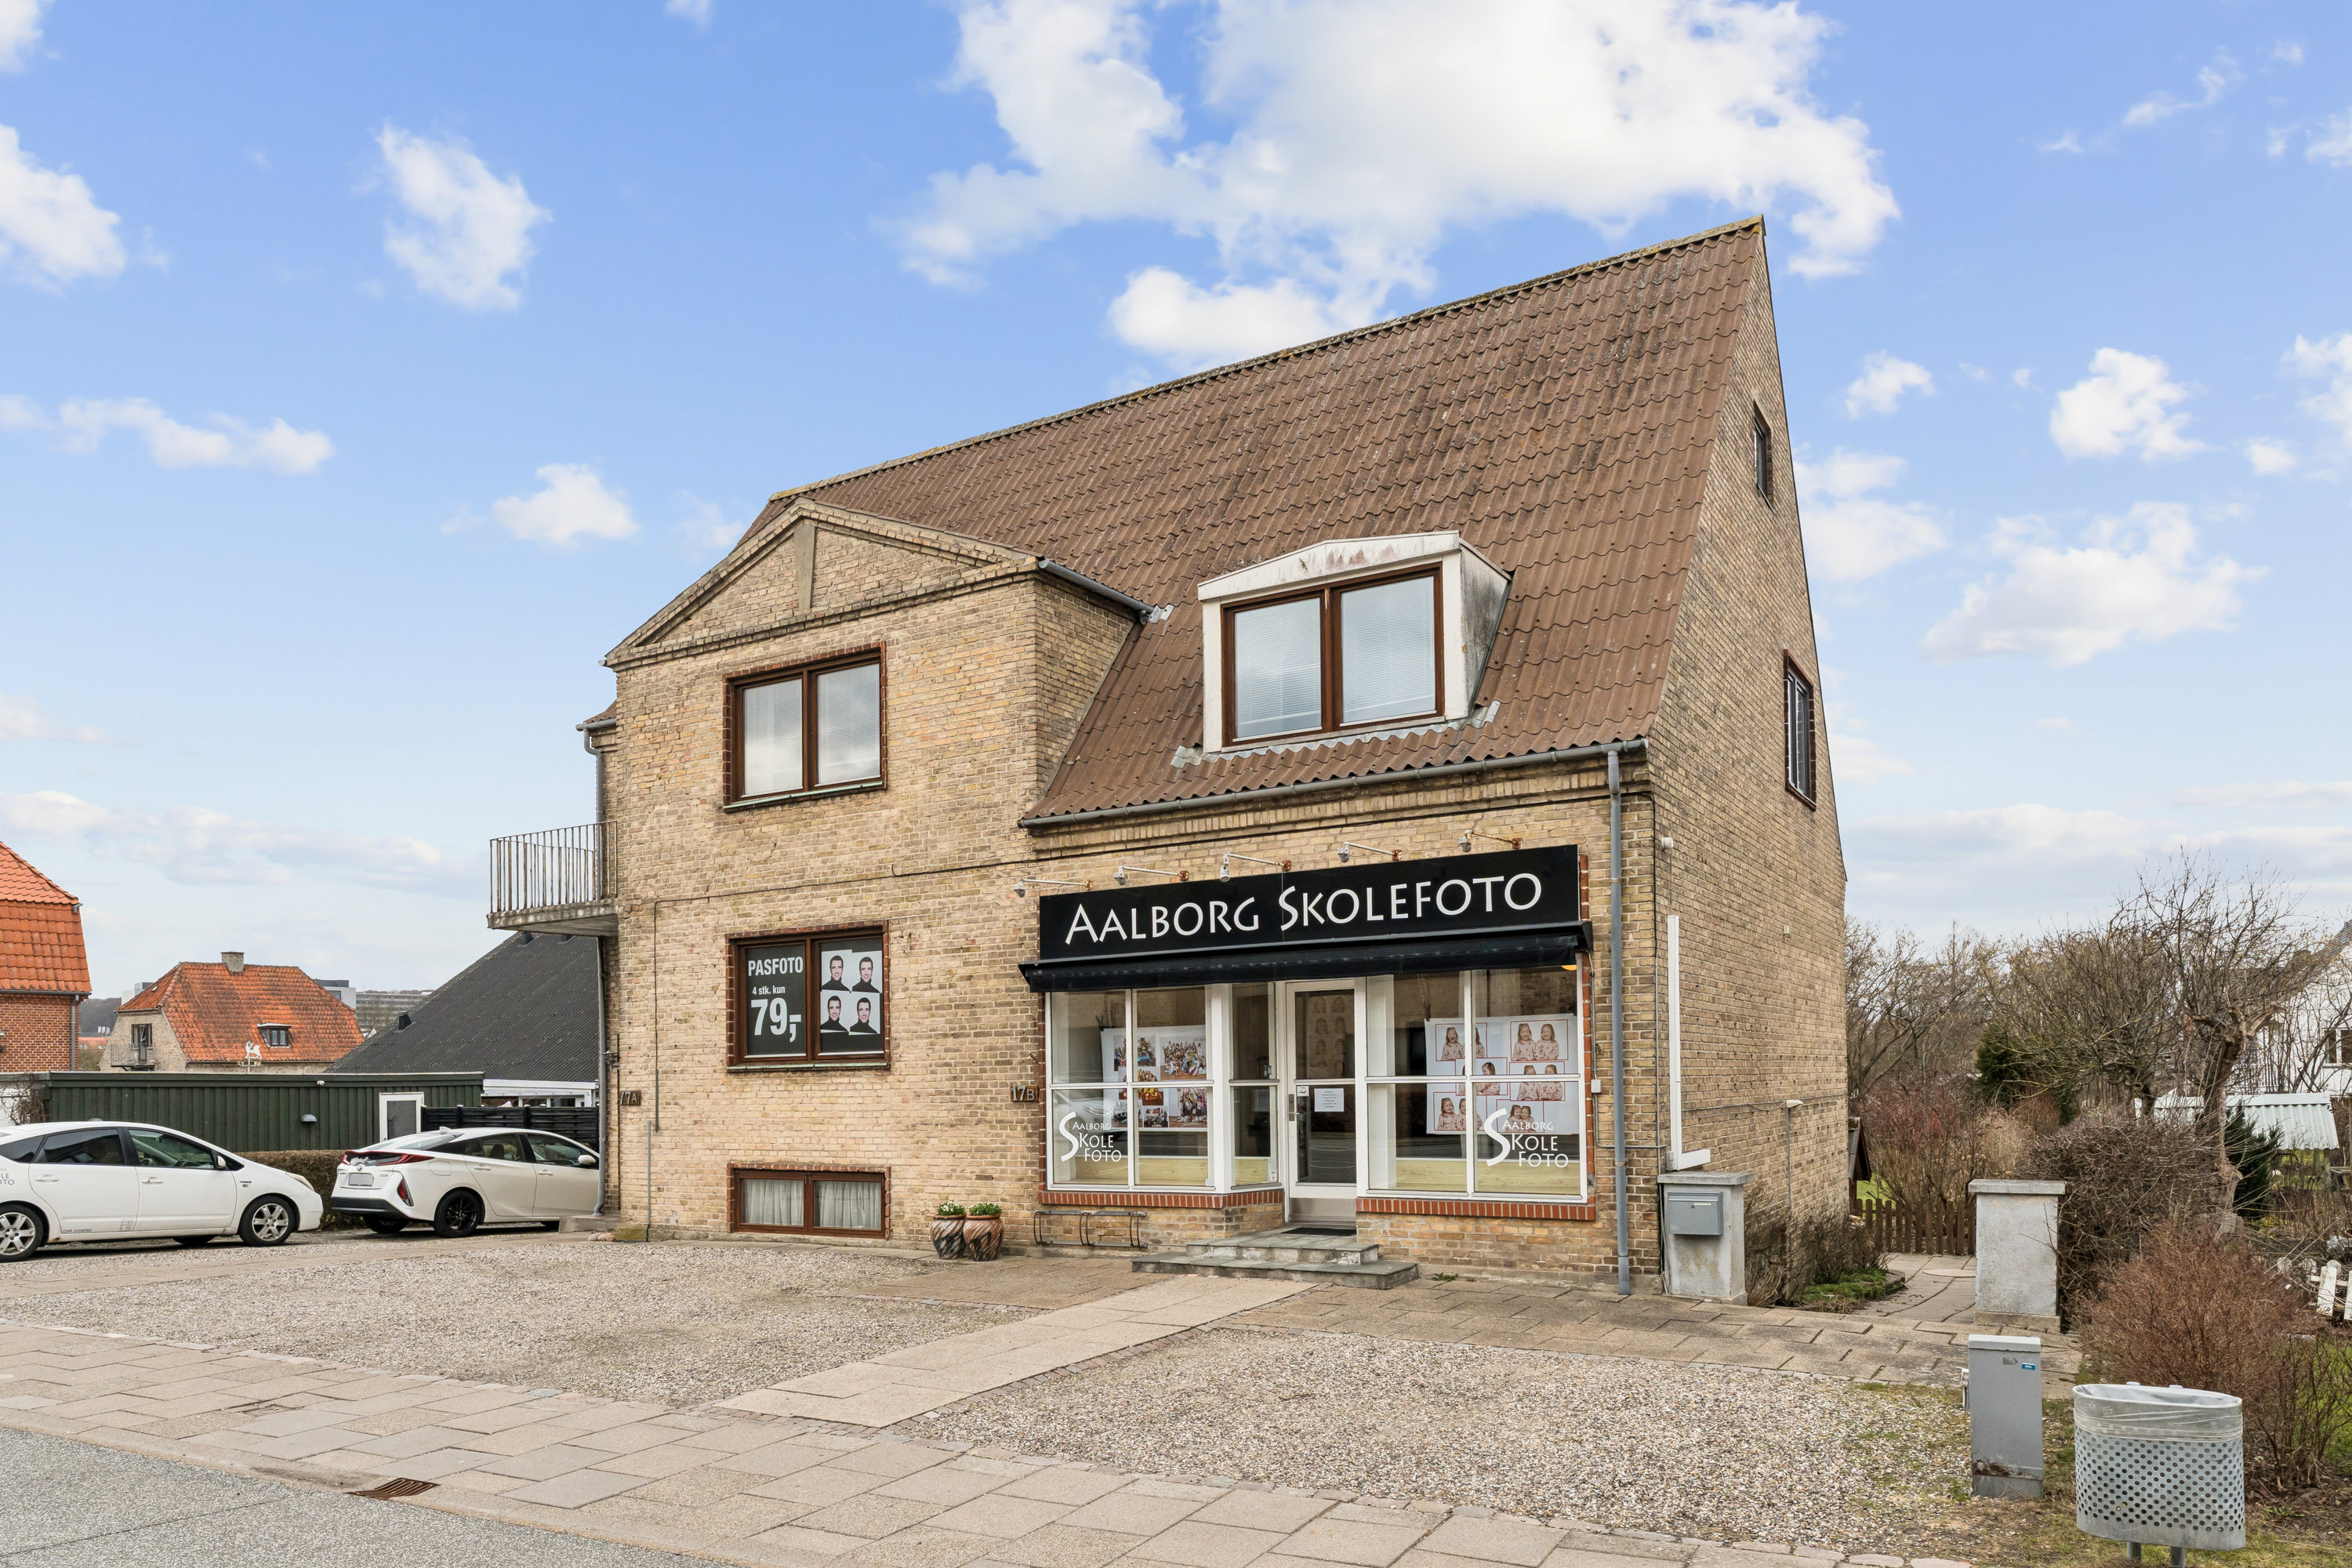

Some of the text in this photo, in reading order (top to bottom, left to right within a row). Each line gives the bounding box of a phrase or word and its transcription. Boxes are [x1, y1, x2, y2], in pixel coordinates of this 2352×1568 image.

[1065, 873, 1542, 946] AALBORG SKOLEFOTO
[748, 956, 804, 977] PASFOTO
[752, 985, 786, 996] 4 stk. kun
[750, 997, 801, 1043] 79,-
[1011, 1084, 1035, 1102] 17B
[1072, 1121, 1111, 1131] AALBORG
[1501, 1120, 1554, 1131] AALBORG
[1084, 1148, 1122, 1162] FOTO
[1519, 1151, 1569, 1168] FOTO
